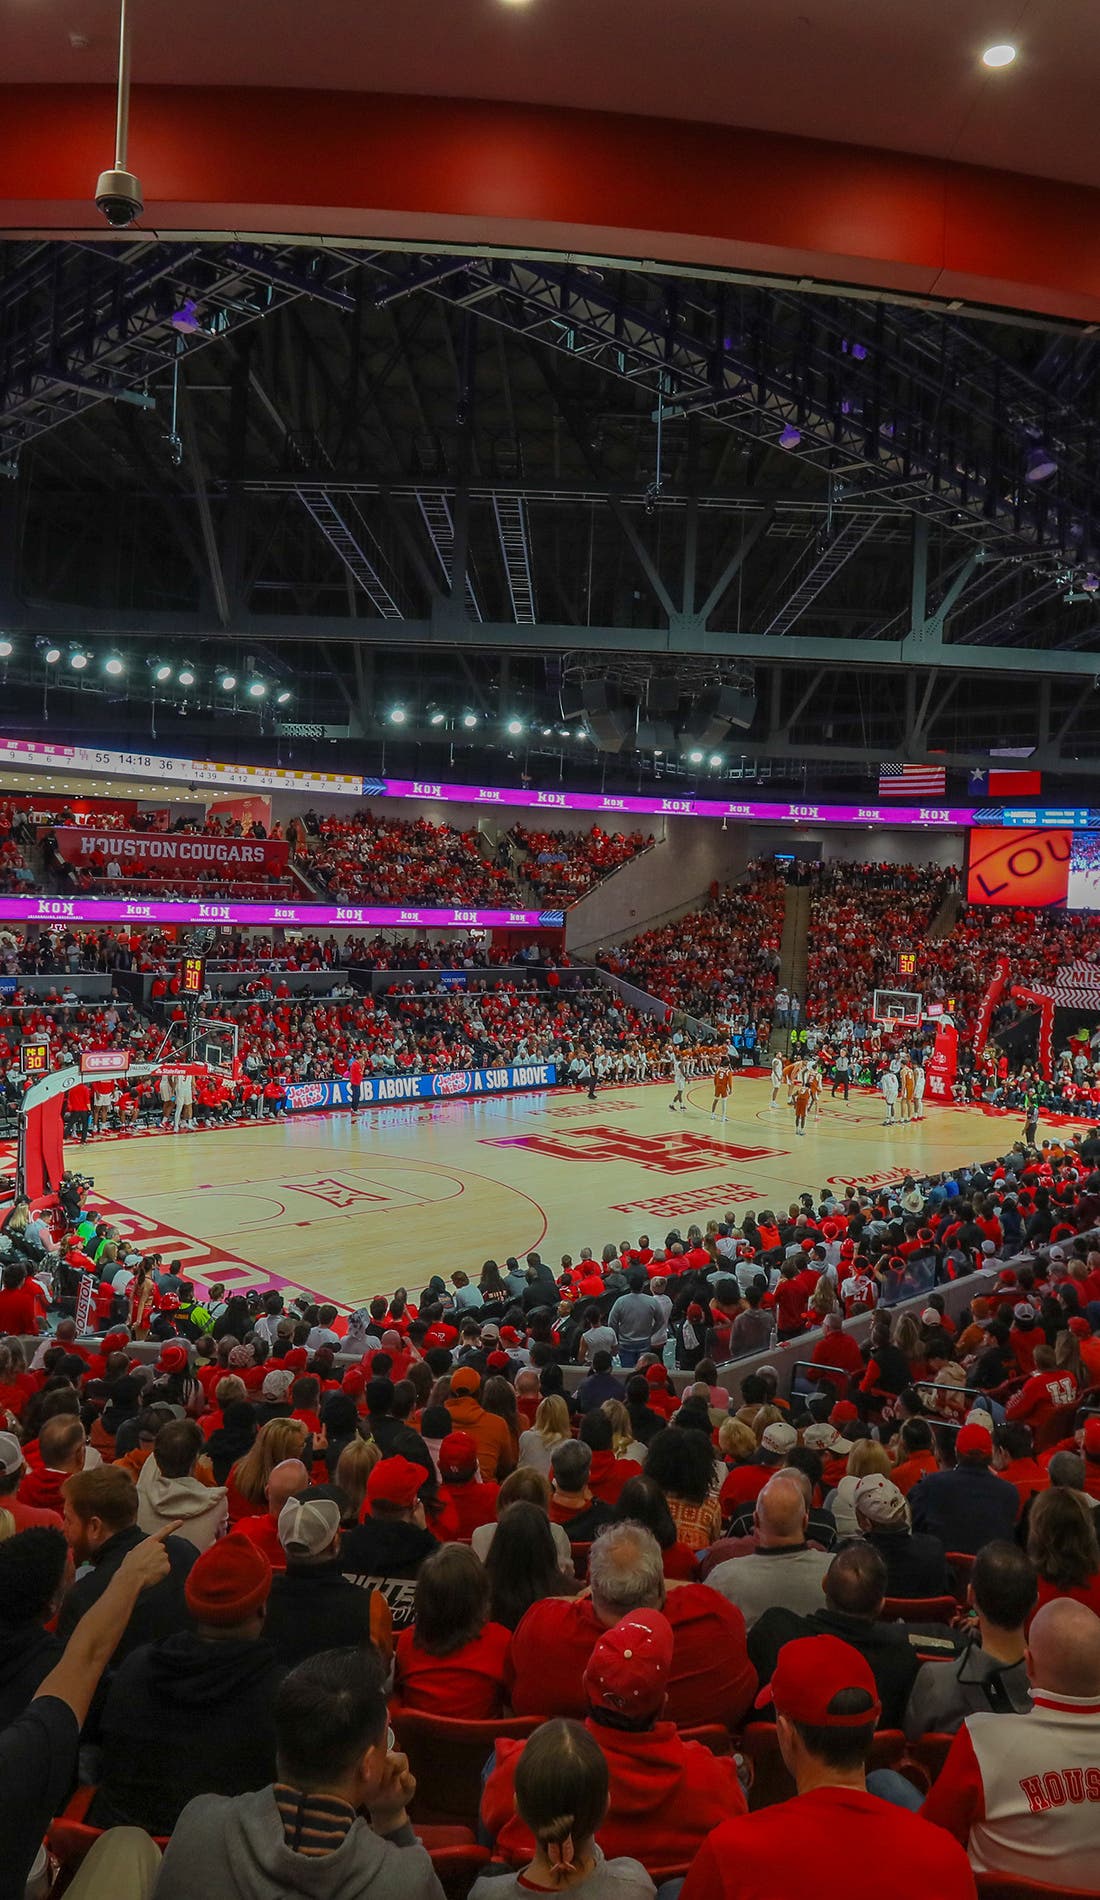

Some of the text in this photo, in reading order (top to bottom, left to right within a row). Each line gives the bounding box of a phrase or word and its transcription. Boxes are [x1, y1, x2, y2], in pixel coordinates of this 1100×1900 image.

[95, 753, 173, 770] 55 14:18 36
[81, 836, 265, 863] HOUSTON COUGARS
[900, 960, 914, 973] 30
[185, 970, 199, 989] 30
[28, 1056, 42, 1068] 30
[474, 1066, 549, 1090] A SUB ABOVE
[288, 1083, 322, 1099] Jersey
[333, 1083, 342, 1104] A
[378, 1077, 421, 1101] ABOVE
[608, 1183, 754, 1214] FERTITTA
[648, 1190, 769, 1218] CENTER
